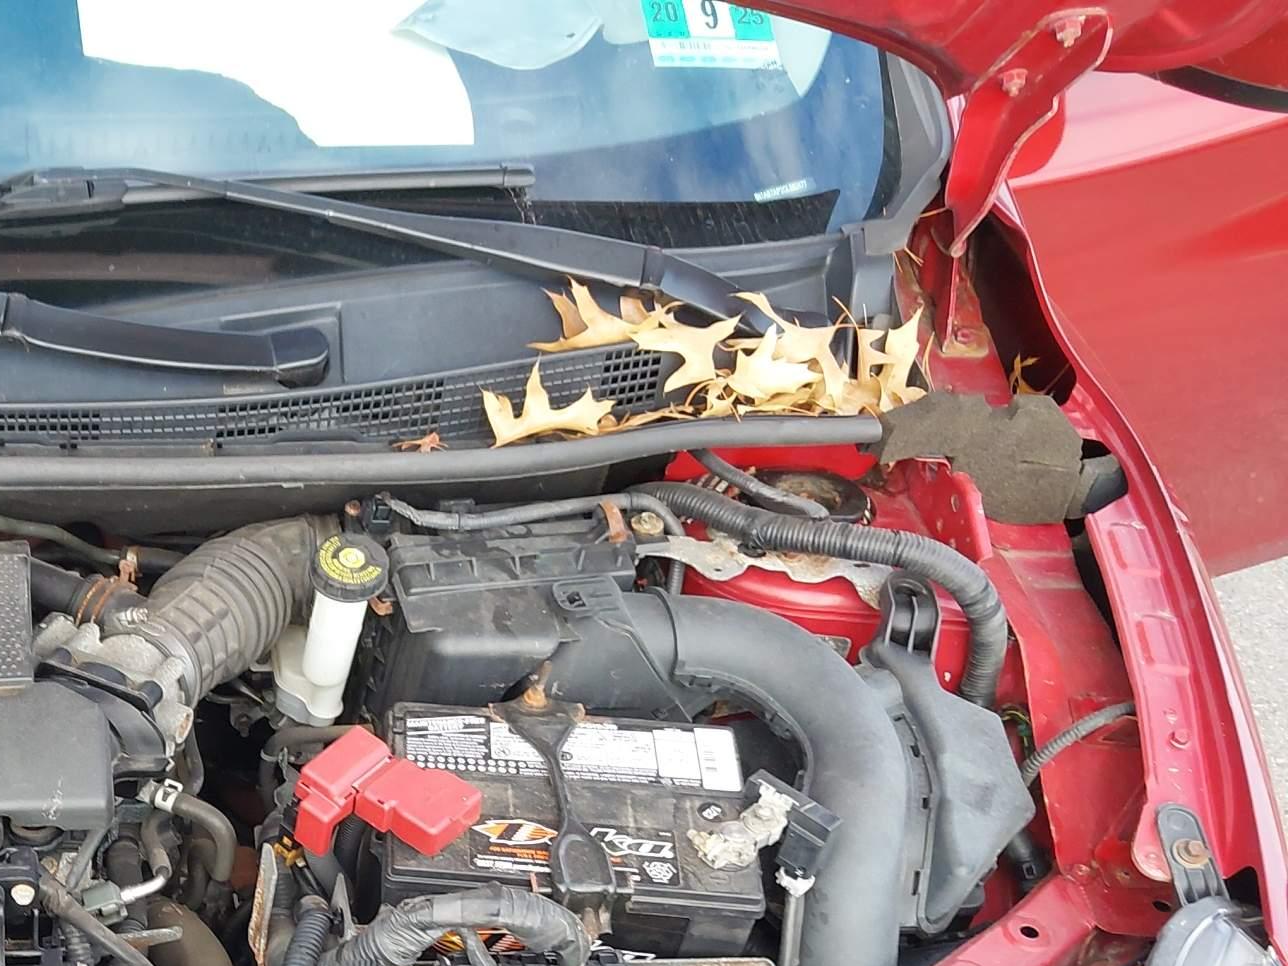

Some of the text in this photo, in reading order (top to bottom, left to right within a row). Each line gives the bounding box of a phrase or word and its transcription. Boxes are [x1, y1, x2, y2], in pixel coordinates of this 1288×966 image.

[652, 0, 764, 29] 20 9 25
